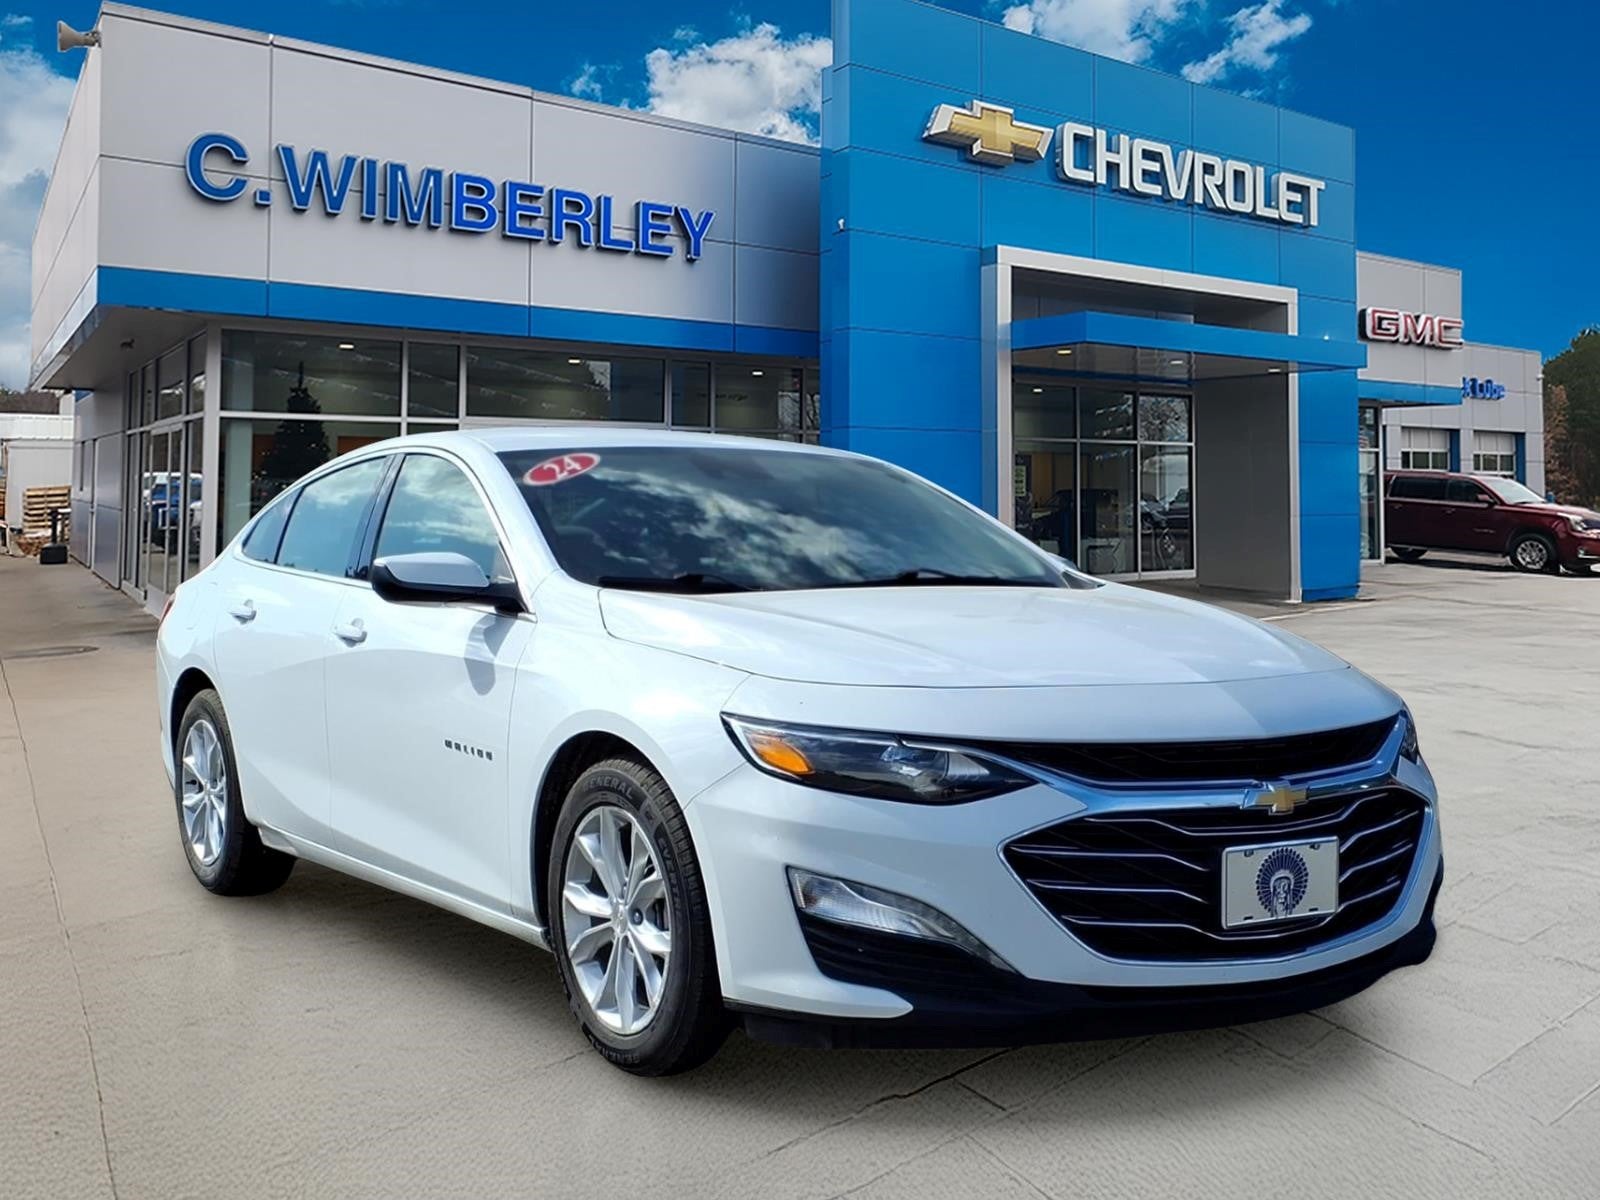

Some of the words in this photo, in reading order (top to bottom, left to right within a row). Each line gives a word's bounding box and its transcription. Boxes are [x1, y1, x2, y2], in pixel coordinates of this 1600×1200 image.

[1056, 121, 1325, 227] CHEVROLET
[1361, 306, 1464, 350] GMC
[543, 456, 581, 478] 24
